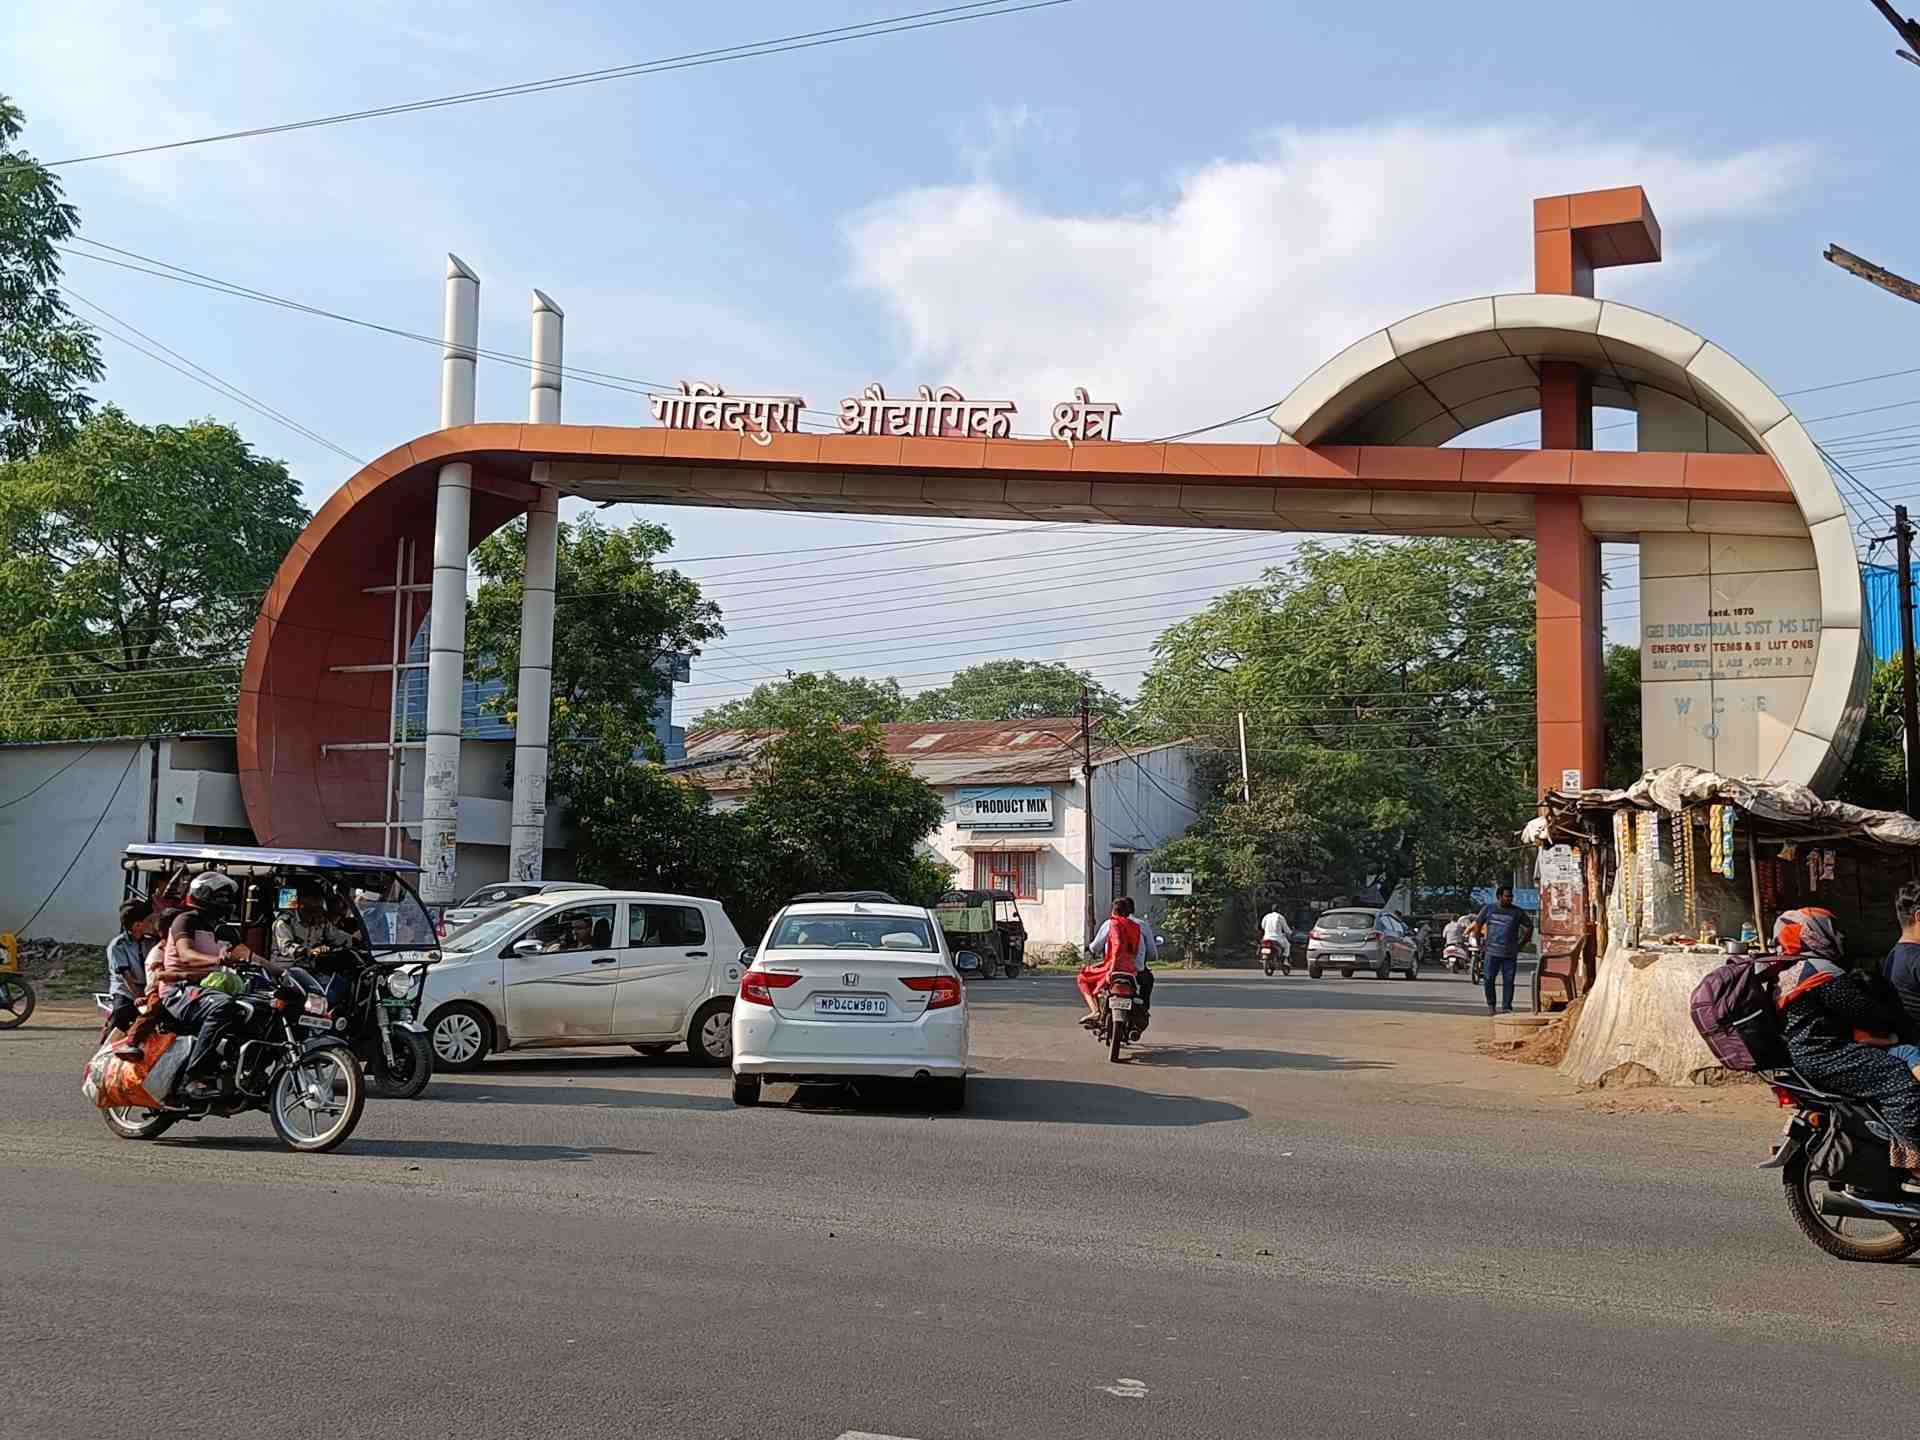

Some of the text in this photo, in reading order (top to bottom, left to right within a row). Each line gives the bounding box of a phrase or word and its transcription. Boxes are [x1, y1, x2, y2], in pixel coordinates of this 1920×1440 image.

[648, 382, 1121, 448] गोविंदपुरा औद्योगिक क्षेत्र
[1668, 621, 1741, 637] INDUSTRIAL
[1651, 642, 1690, 653] ENERGY
[975, 798, 1048, 813] PRODUCT MIX
